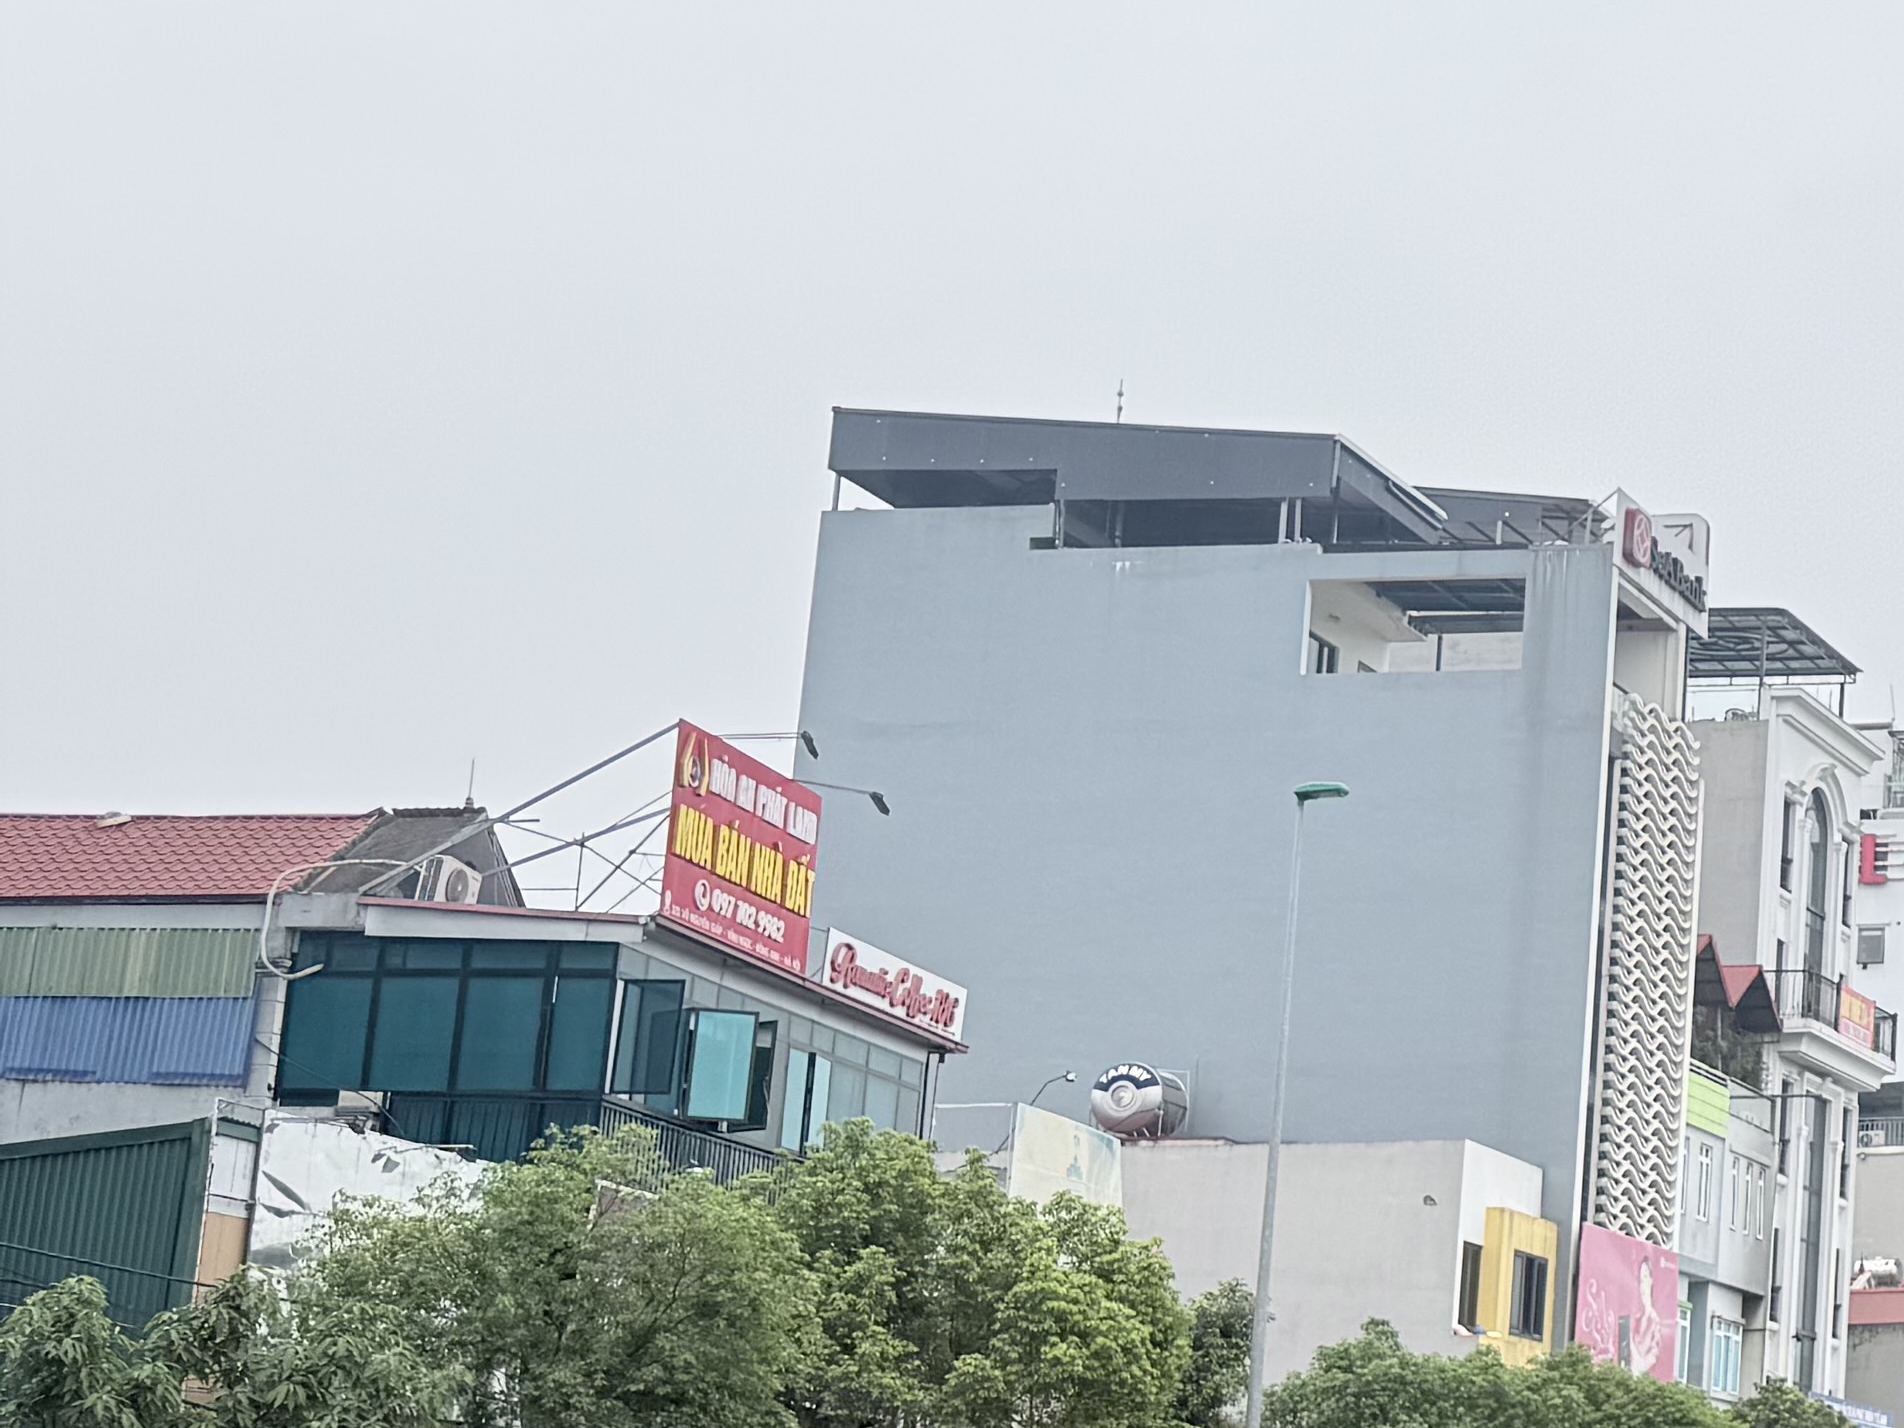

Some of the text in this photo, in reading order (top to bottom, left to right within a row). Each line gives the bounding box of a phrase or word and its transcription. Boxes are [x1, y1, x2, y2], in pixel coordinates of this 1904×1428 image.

[674, 804, 713, 870] MUA
[716, 820, 751, 888] BÁN
[752, 841, 784, 904] NHÀ
